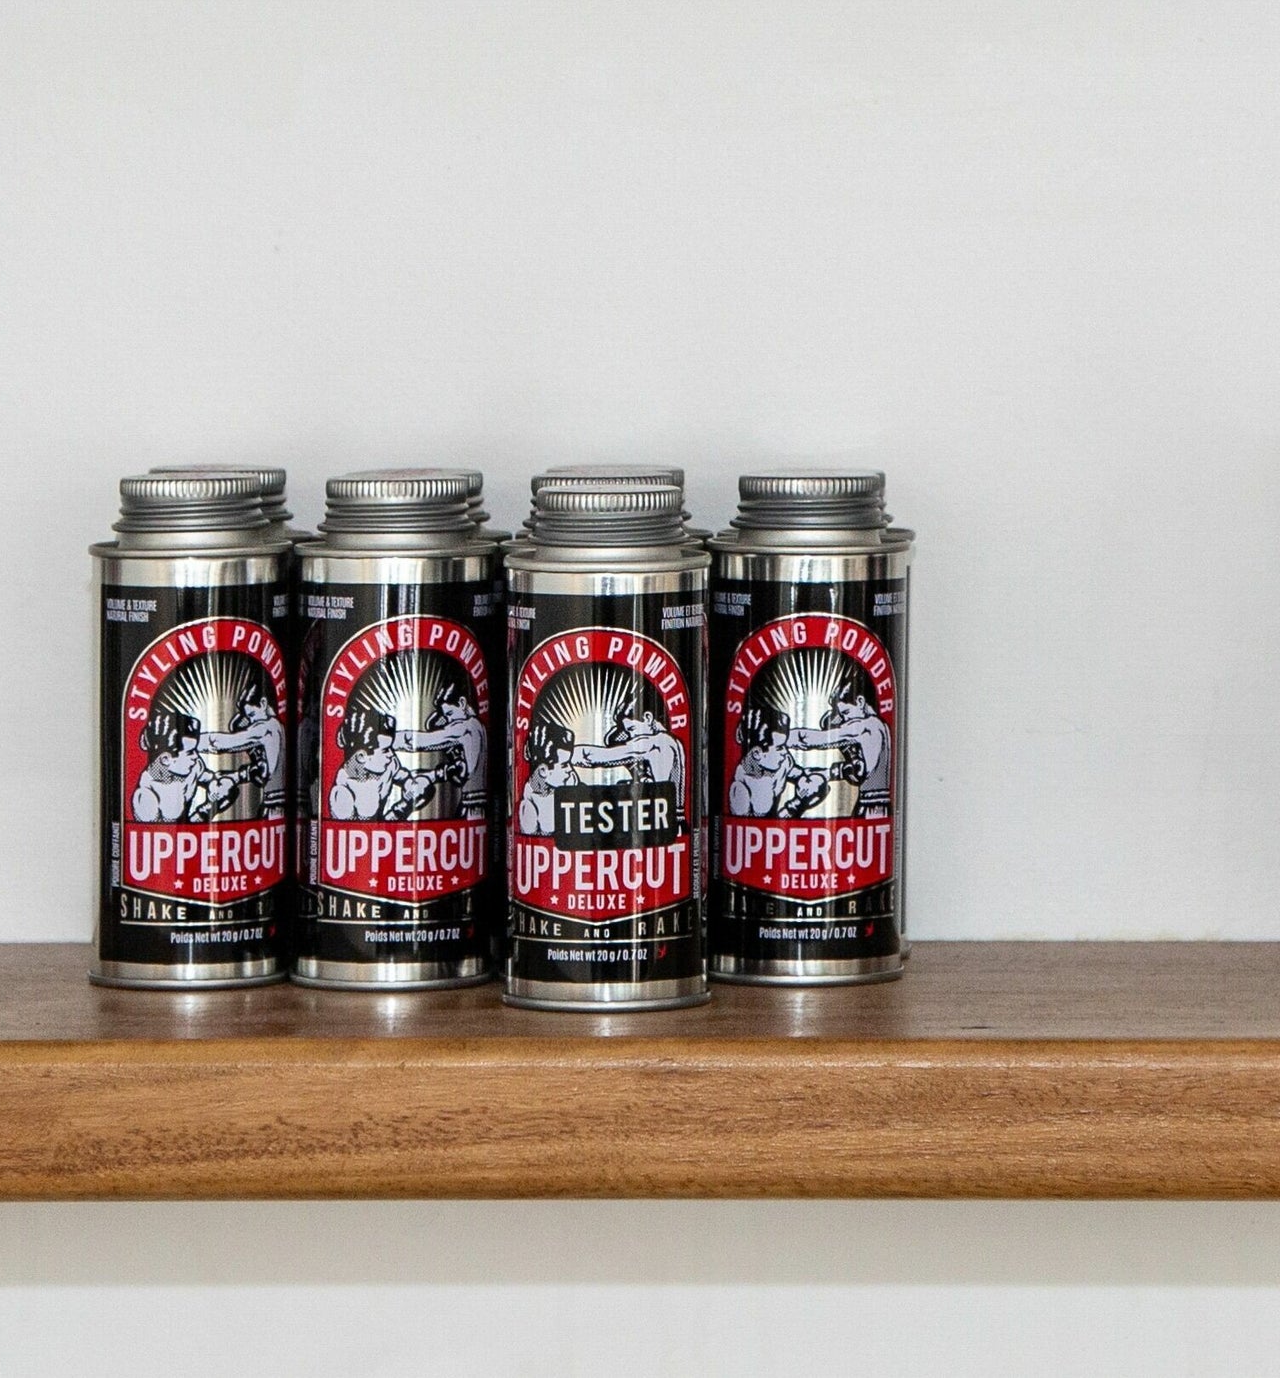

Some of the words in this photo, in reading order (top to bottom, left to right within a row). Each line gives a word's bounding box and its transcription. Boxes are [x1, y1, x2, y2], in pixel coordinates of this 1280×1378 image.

[129, 625, 216, 720] STYLING
[231, 626, 287, 714] POWDER
[326, 624, 413, 718] STYLING
[429, 625, 489, 714] POWDER
[517, 636, 590, 730] STYLING
[607, 636, 687, 730] POWDER
[727, 623, 807, 714] STYLING
[824, 622, 893, 714] POWDER
[561, 798, 669, 834] TESTER
[129, 828, 286, 882] UPPERCUT
[326, 826, 487, 880] UPPERCUT
[517, 844, 686, 895] UPPERCUT
[725, 826, 890, 875] UPPERCUT
[192, 876, 247, 893] DELUXE
[387, 874, 444, 891] DELUXE
[567, 894, 626, 909] DELUXE
[781, 873, 839, 888] DELUXE
[120, 897, 188, 920] SHAKE
[208, 909, 234, 920] AND
[318, 896, 381, 919] SHAKE
[403, 909, 429, 919] AND
